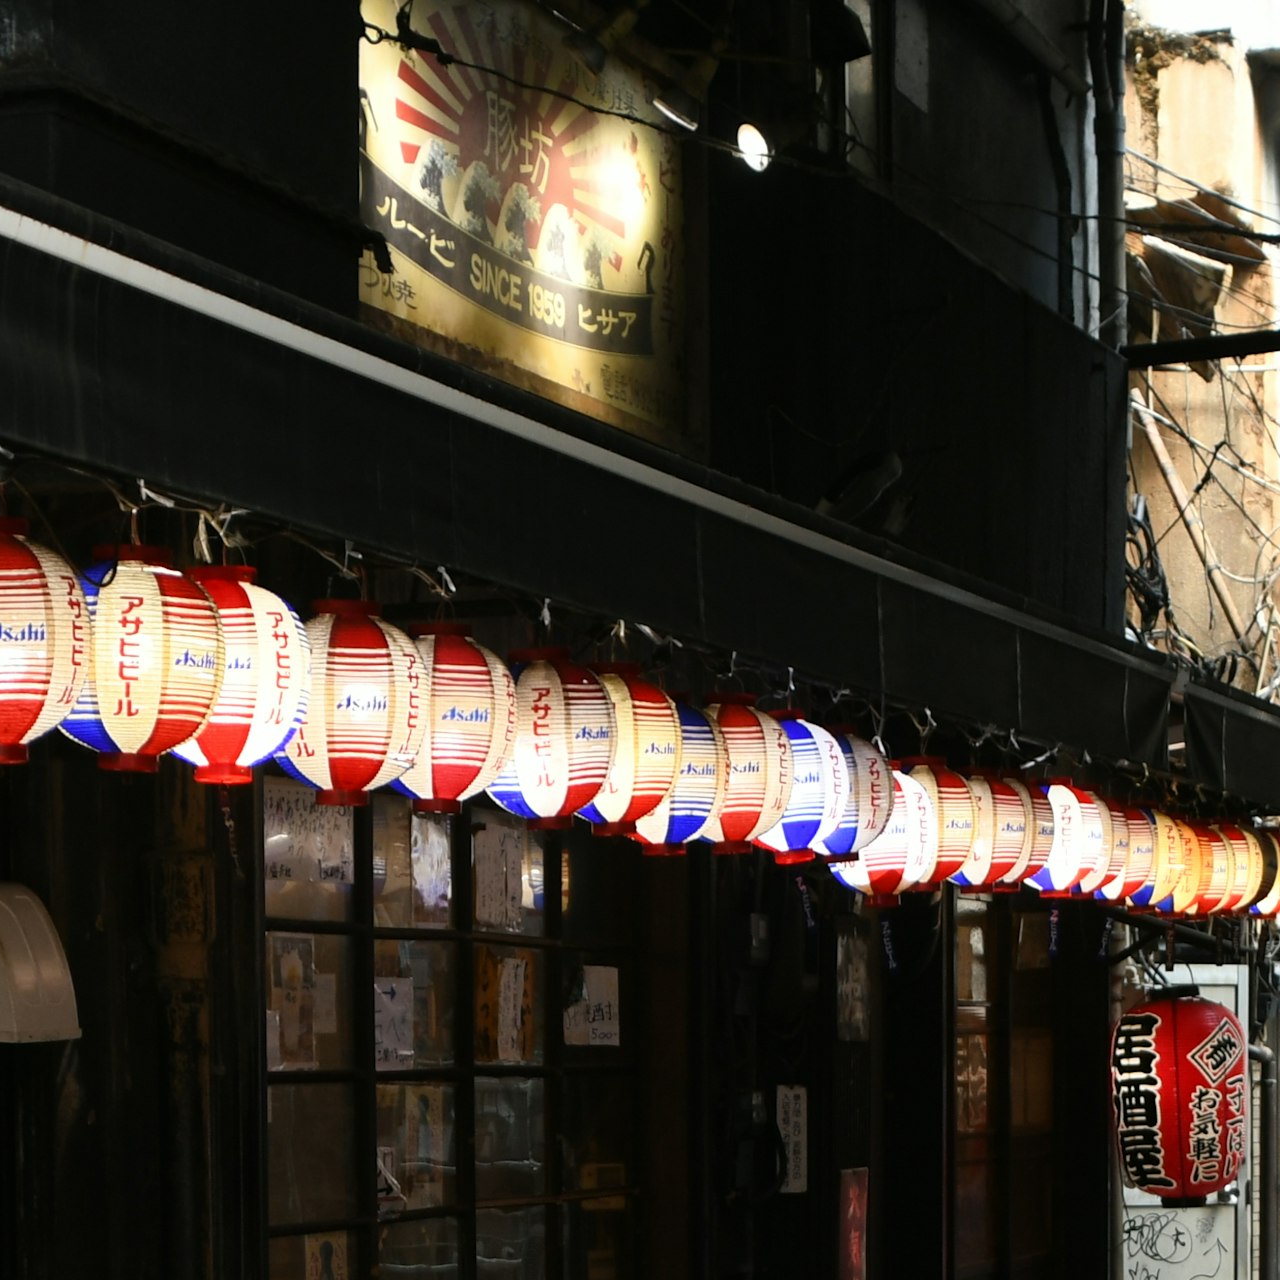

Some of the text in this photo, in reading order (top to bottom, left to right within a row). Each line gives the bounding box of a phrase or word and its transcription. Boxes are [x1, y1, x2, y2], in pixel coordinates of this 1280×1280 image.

[485, 89, 554, 194] 豚坊
[376, 196, 638, 339] ルービ SINCE 1959 ヒサア
[56, 575, 85, 705] アサヒビール
[114, 596, 144, 717] アサヒビール
[265, 612, 291, 725] アサヒビール
[336, 694, 388, 713] Asahi
[441, 705, 490, 723] Asahi
[531, 687, 556, 788] アサヒビール
[575, 725, 610, 742] Asahi
[680, 761, 716, 776] Asahi
[732, 761, 761, 774] sahi
[793, 771, 821, 785] sahi
[865, 757, 882, 830] アサヒビール
[1113, 1012, 1176, 1188] 居酒屋
[1189, 1086, 1222, 1182] お気軽に
